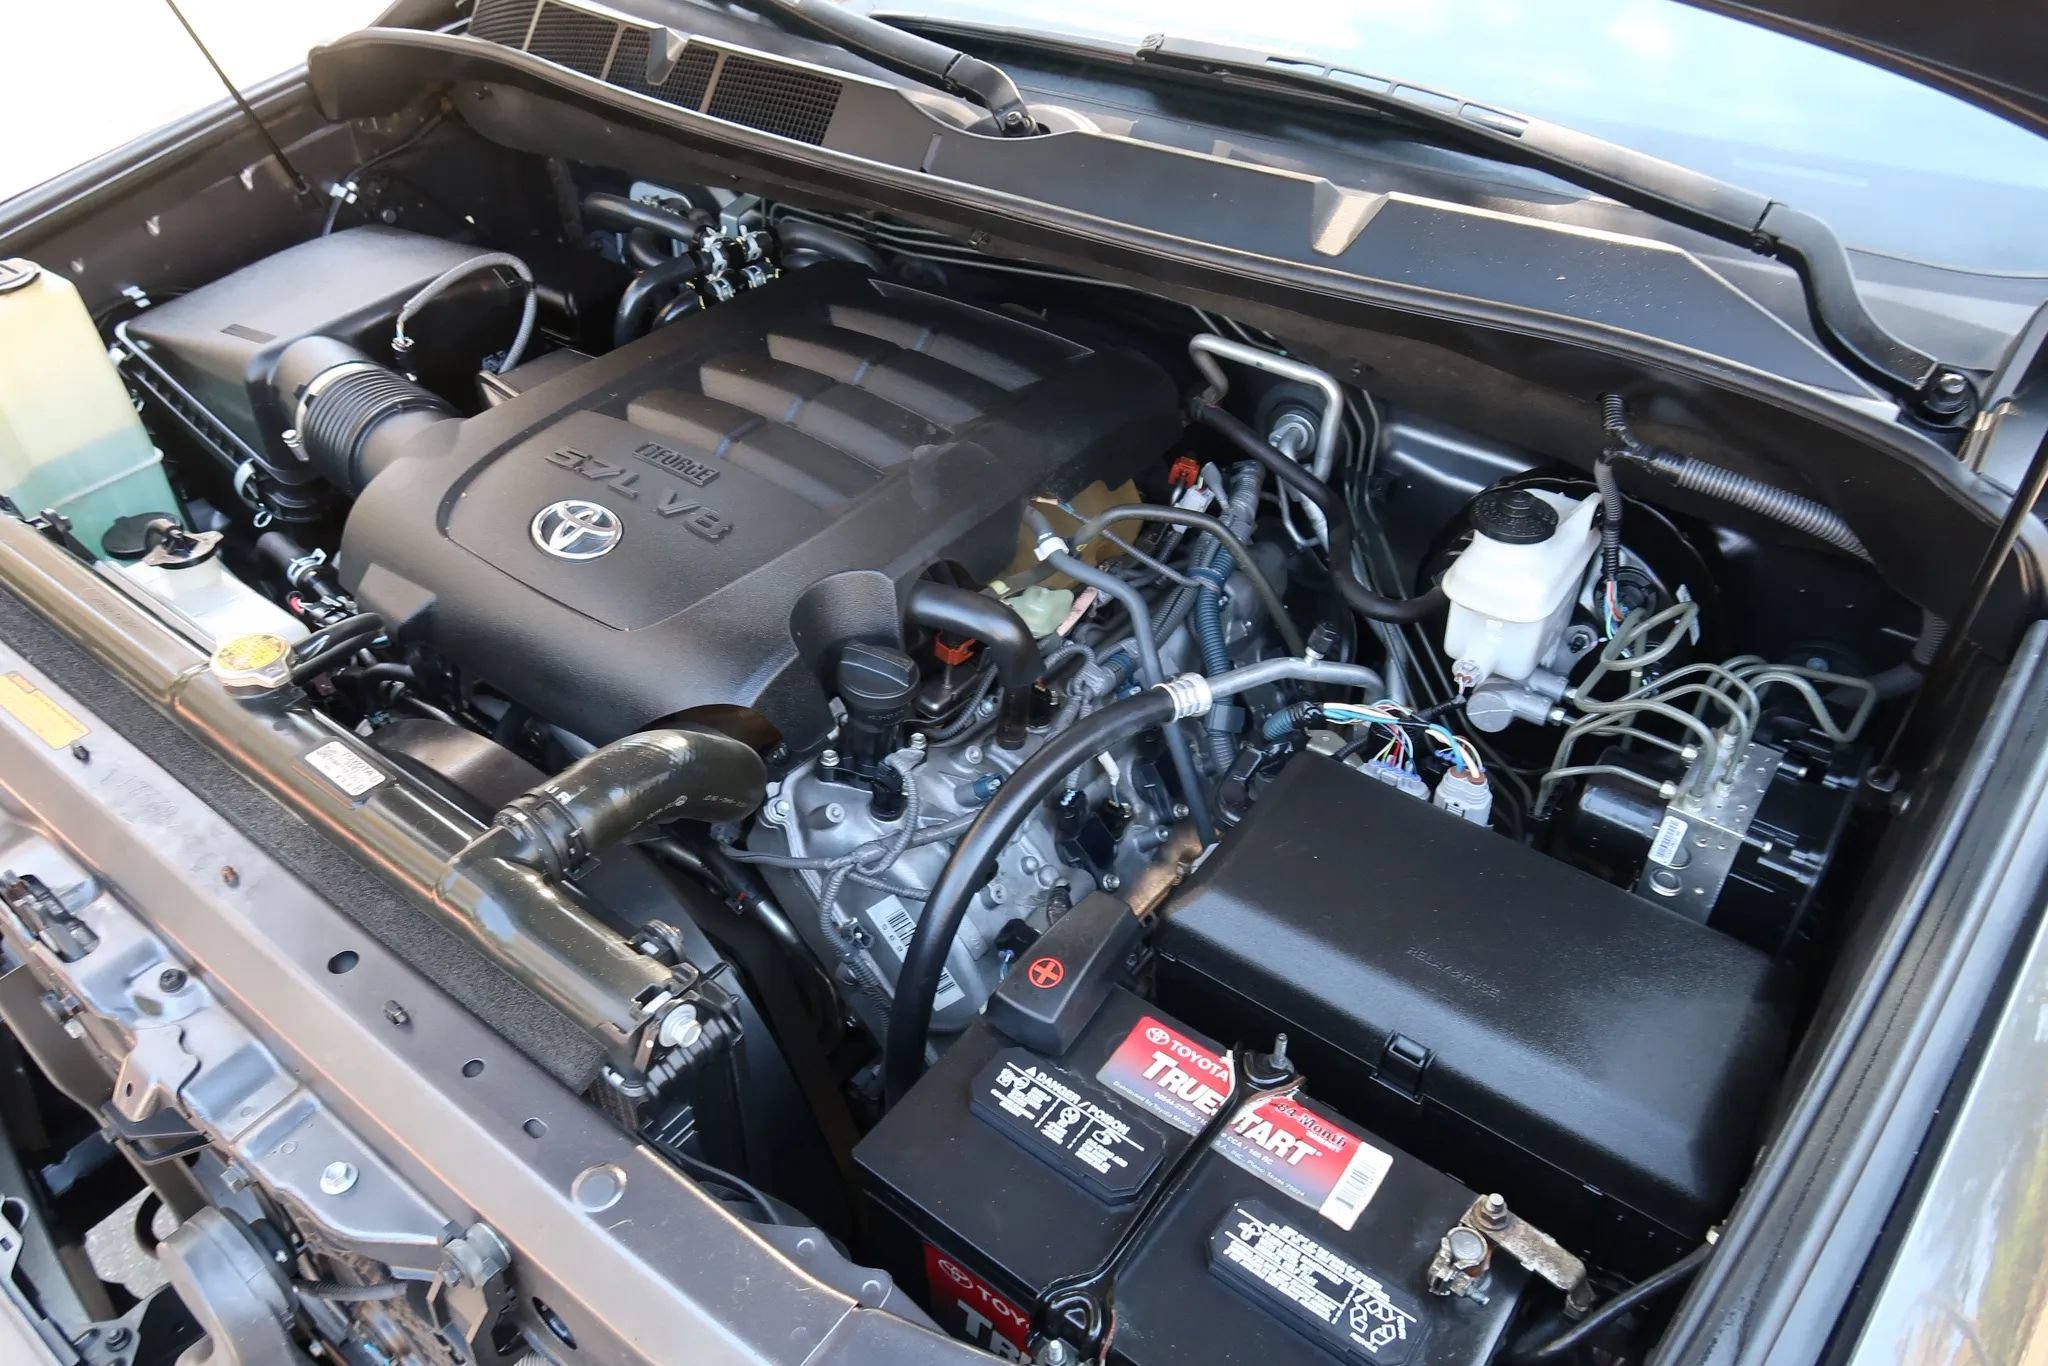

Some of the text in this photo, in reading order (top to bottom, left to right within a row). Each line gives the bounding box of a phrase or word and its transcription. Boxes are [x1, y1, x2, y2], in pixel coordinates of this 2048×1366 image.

[655, 486, 734, 543] V8
[1167, 1038, 1231, 1082] TOYOTA
[1275, 1101, 1348, 1148] 84 Month
[977, 1285, 1030, 1330] TOY
